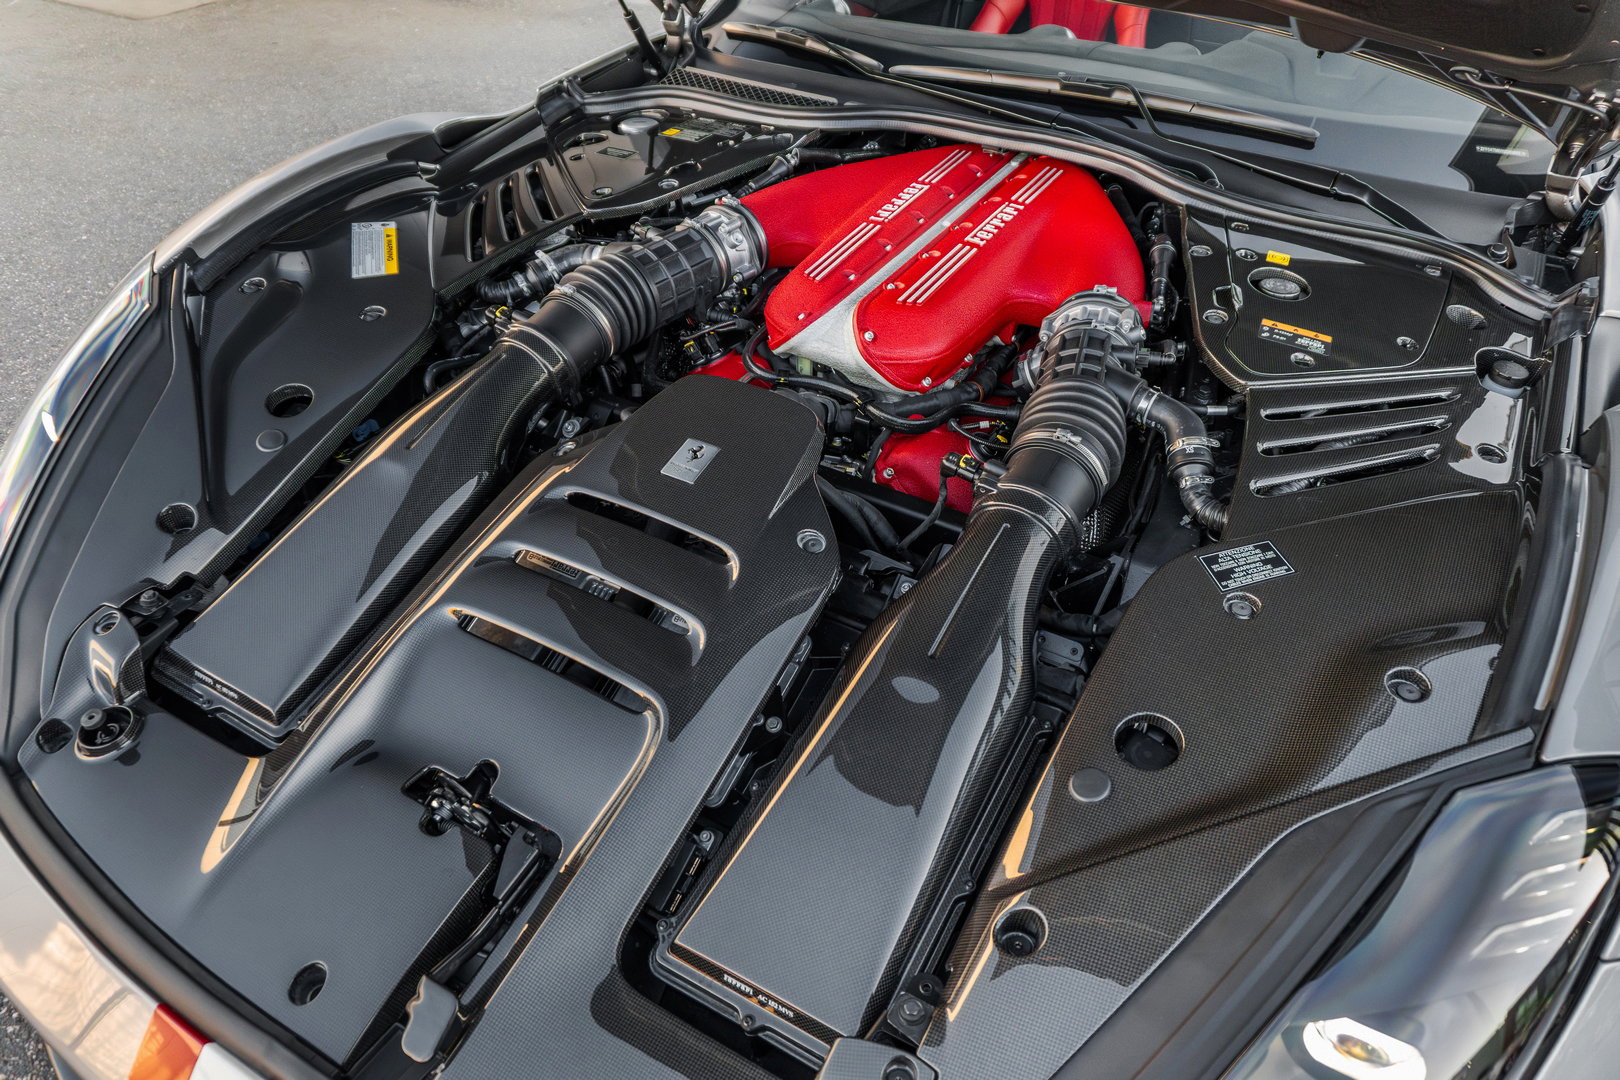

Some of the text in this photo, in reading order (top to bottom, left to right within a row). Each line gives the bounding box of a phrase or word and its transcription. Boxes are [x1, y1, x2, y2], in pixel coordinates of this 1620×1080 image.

[870, 182, 930, 222] Ferrari
[964, 202, 1025, 246] Ferrari
[1218, 546, 1255, 557] ATTENZIONE
[1233, 549, 1262, 558] TENSIONE
[1234, 562, 1263, 572] WARNING
[1246, 564, 1273, 574] VOLTAGE
